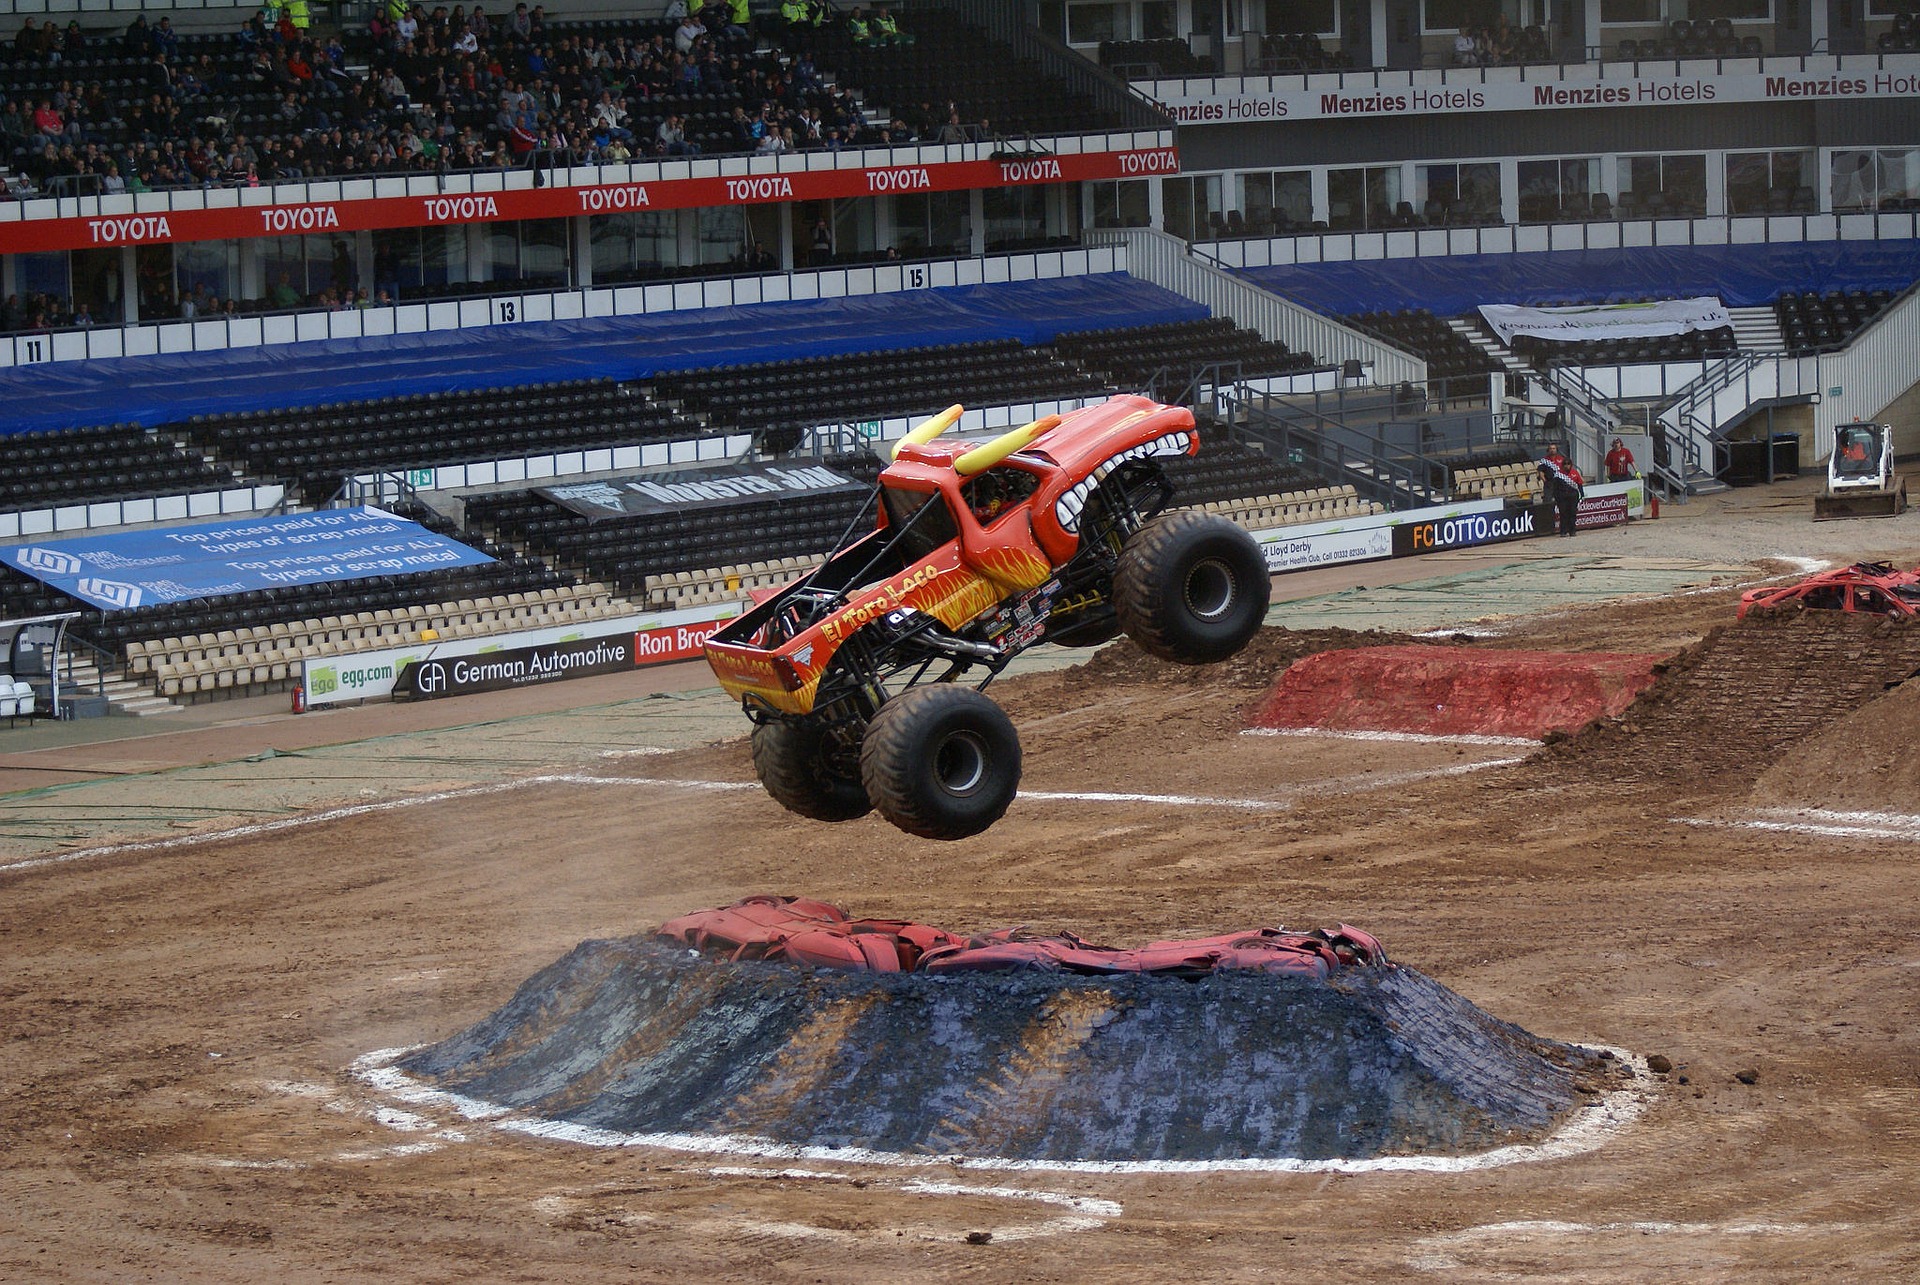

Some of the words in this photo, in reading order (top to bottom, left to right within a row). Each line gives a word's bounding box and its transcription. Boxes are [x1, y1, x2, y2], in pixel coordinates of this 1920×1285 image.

[1534, 84, 1630, 106] Menzies
[1638, 80, 1716, 101] Hotels
[1766, 76, 1867, 97] Menzies
[1874, 74, 1920, 94] Hot
[1228, 96, 1288, 119] Hotels
[1320, 92, 1406, 114] Menzies
[1413, 88, 1485, 110] Hotels
[1000, 159, 1062, 182] TOYOTA
[1118, 151, 1177, 174] TOYOTA
[726, 177, 793, 200] TOYOTA
[866, 168, 931, 191] TOYOTA
[424, 196, 499, 221] TOYOTA
[578, 186, 650, 211] TOYOTA
[89, 216, 172, 243] TOYOTA
[261, 206, 340, 232] TOYOTA
[910, 269, 923, 288] 15
[500, 301, 516, 322] 13
[26, 340, 42, 363] 11
[624, 475, 784, 503] MONSTER
[765, 465, 850, 490] JAM
[166, 528, 209, 544] Top
[208, 525, 273, 542] prices
[273, 518, 318, 533] paid
[313, 516, 346, 526] for
[348, 512, 382, 522] AL
[1413, 510, 1534, 549] FCLOTTO.co.uk
[1575, 512, 1626, 526] enzieshotels.co.uk
[200, 540, 262, 554] types
[262, 535, 285, 546] of
[287, 530, 344, 544] scrap
[343, 522, 402, 537] metal
[1270, 544, 1289, 557] Lloyd
[1290, 541, 1311, 553] Derby
[225, 561, 270, 571] Top
[268, 555, 333, 569] prices
[331, 546, 377, 562] paid
[371, 544, 406, 554] for
[259, 569, 323, 582] types
[321, 563, 345, 575] of
[346, 558, 404, 571] scrap
[402, 549, 462, 565] metal
[1268, 560, 1288, 568] Premier
[1290, 556, 1307, 565] Health
[1322, 552, 1333, 560] Call
[820, 619, 843, 643] El
[841, 596, 888, 630] Toro
[884, 564, 938, 607] Loco
[640, 629, 672, 655] Ron
[341, 664, 392, 688] egg.com
[418, 662, 446, 692] GA
[454, 655, 525, 684] German
[530, 640, 626, 674] Automotive
